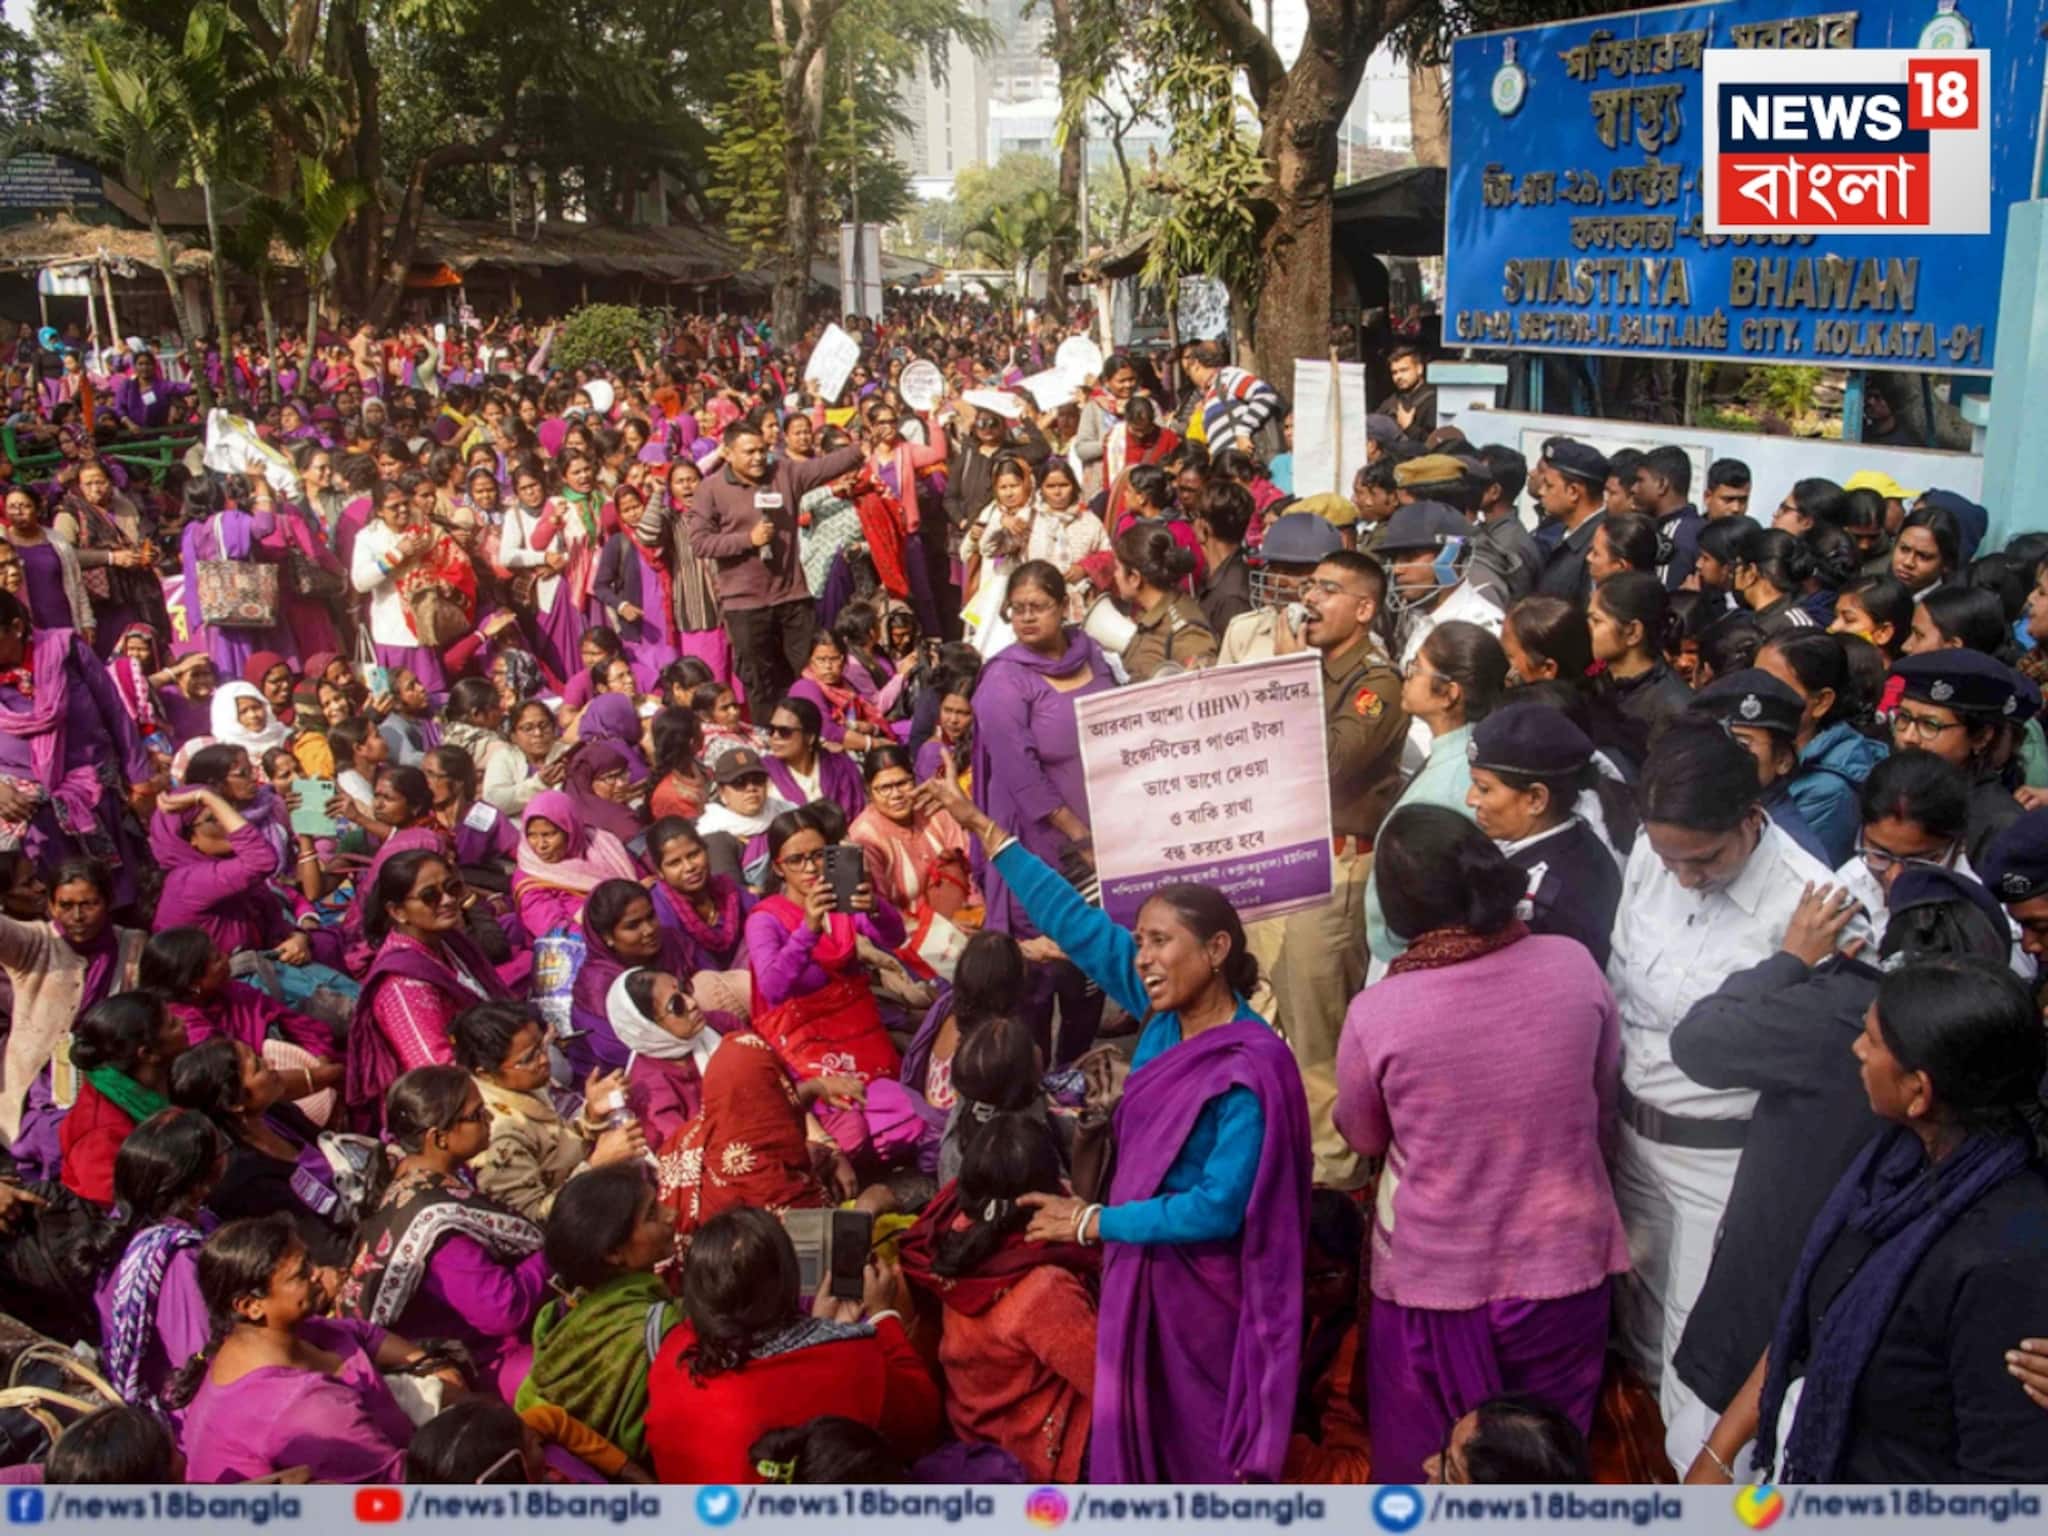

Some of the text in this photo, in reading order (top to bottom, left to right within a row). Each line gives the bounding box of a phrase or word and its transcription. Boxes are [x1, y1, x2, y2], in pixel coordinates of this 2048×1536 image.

[1570, 214, 1676, 249] কলকাতা
[1503, 254, 1920, 312] SWASTHYA BHAWAN
[1815, 319, 1936, 358] KOLKATA
[1088, 710, 1144, 738] আরবান
[1147, 704, 1184, 727] আশা
[1188, 691, 1250, 723] (HHW)
[1205, 725, 1250, 751] পাওনা
[1252, 719, 1286, 743] টাকা
[1142, 758, 1269, 797] ভাগে ভাগে দেওয়া
[1169, 797, 1254, 827] ও বাকি রাখা
[1189, 837, 1235, 857] করতে
[1239, 829, 1265, 850] হবে
